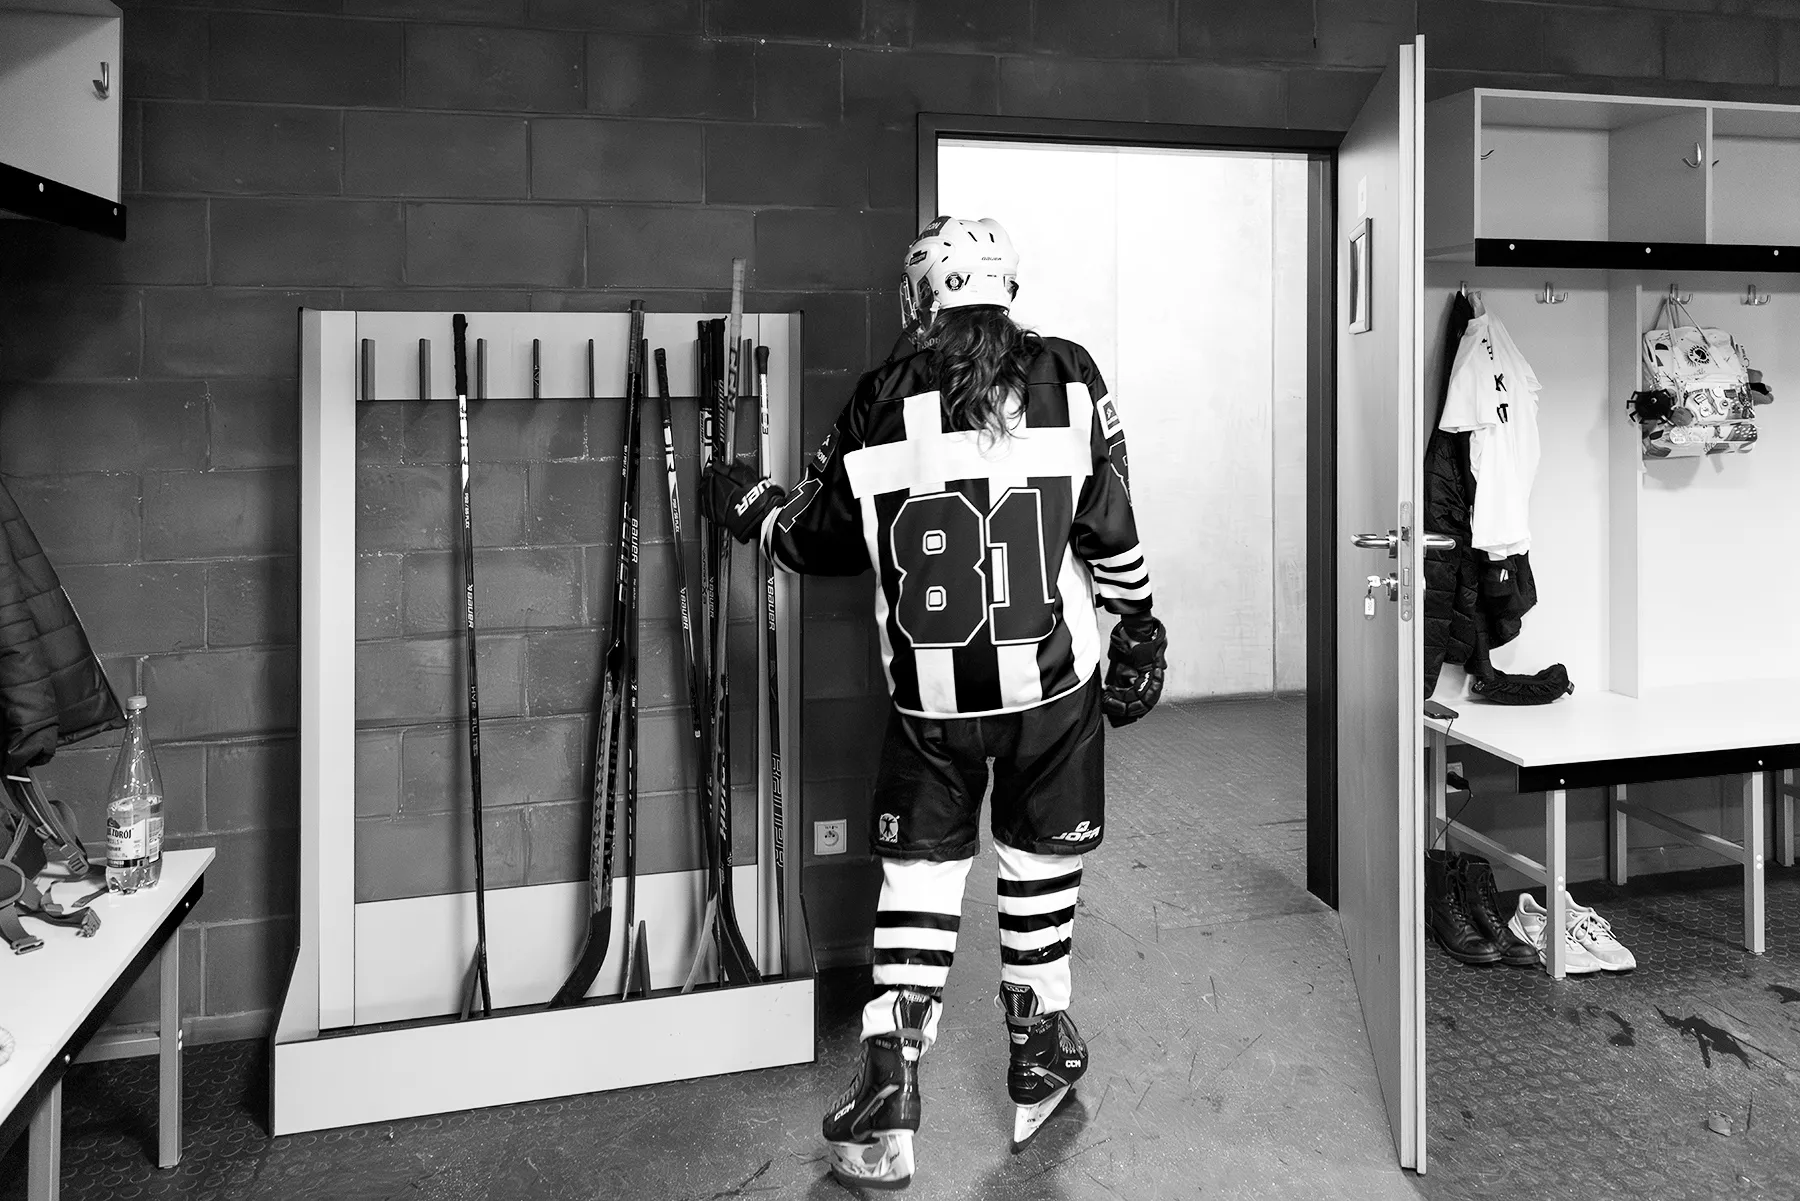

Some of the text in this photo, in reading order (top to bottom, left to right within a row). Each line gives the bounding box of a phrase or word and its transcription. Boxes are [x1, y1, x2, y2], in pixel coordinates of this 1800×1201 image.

[631, 518, 639, 564] BAUER
[890, 487, 1057, 648] 81
[466, 591, 474, 629] BAUER
[767, 585, 776, 631] BAUER
[1065, 1059, 1081, 1068] CCM
[834, 1099, 856, 1122] CCM
